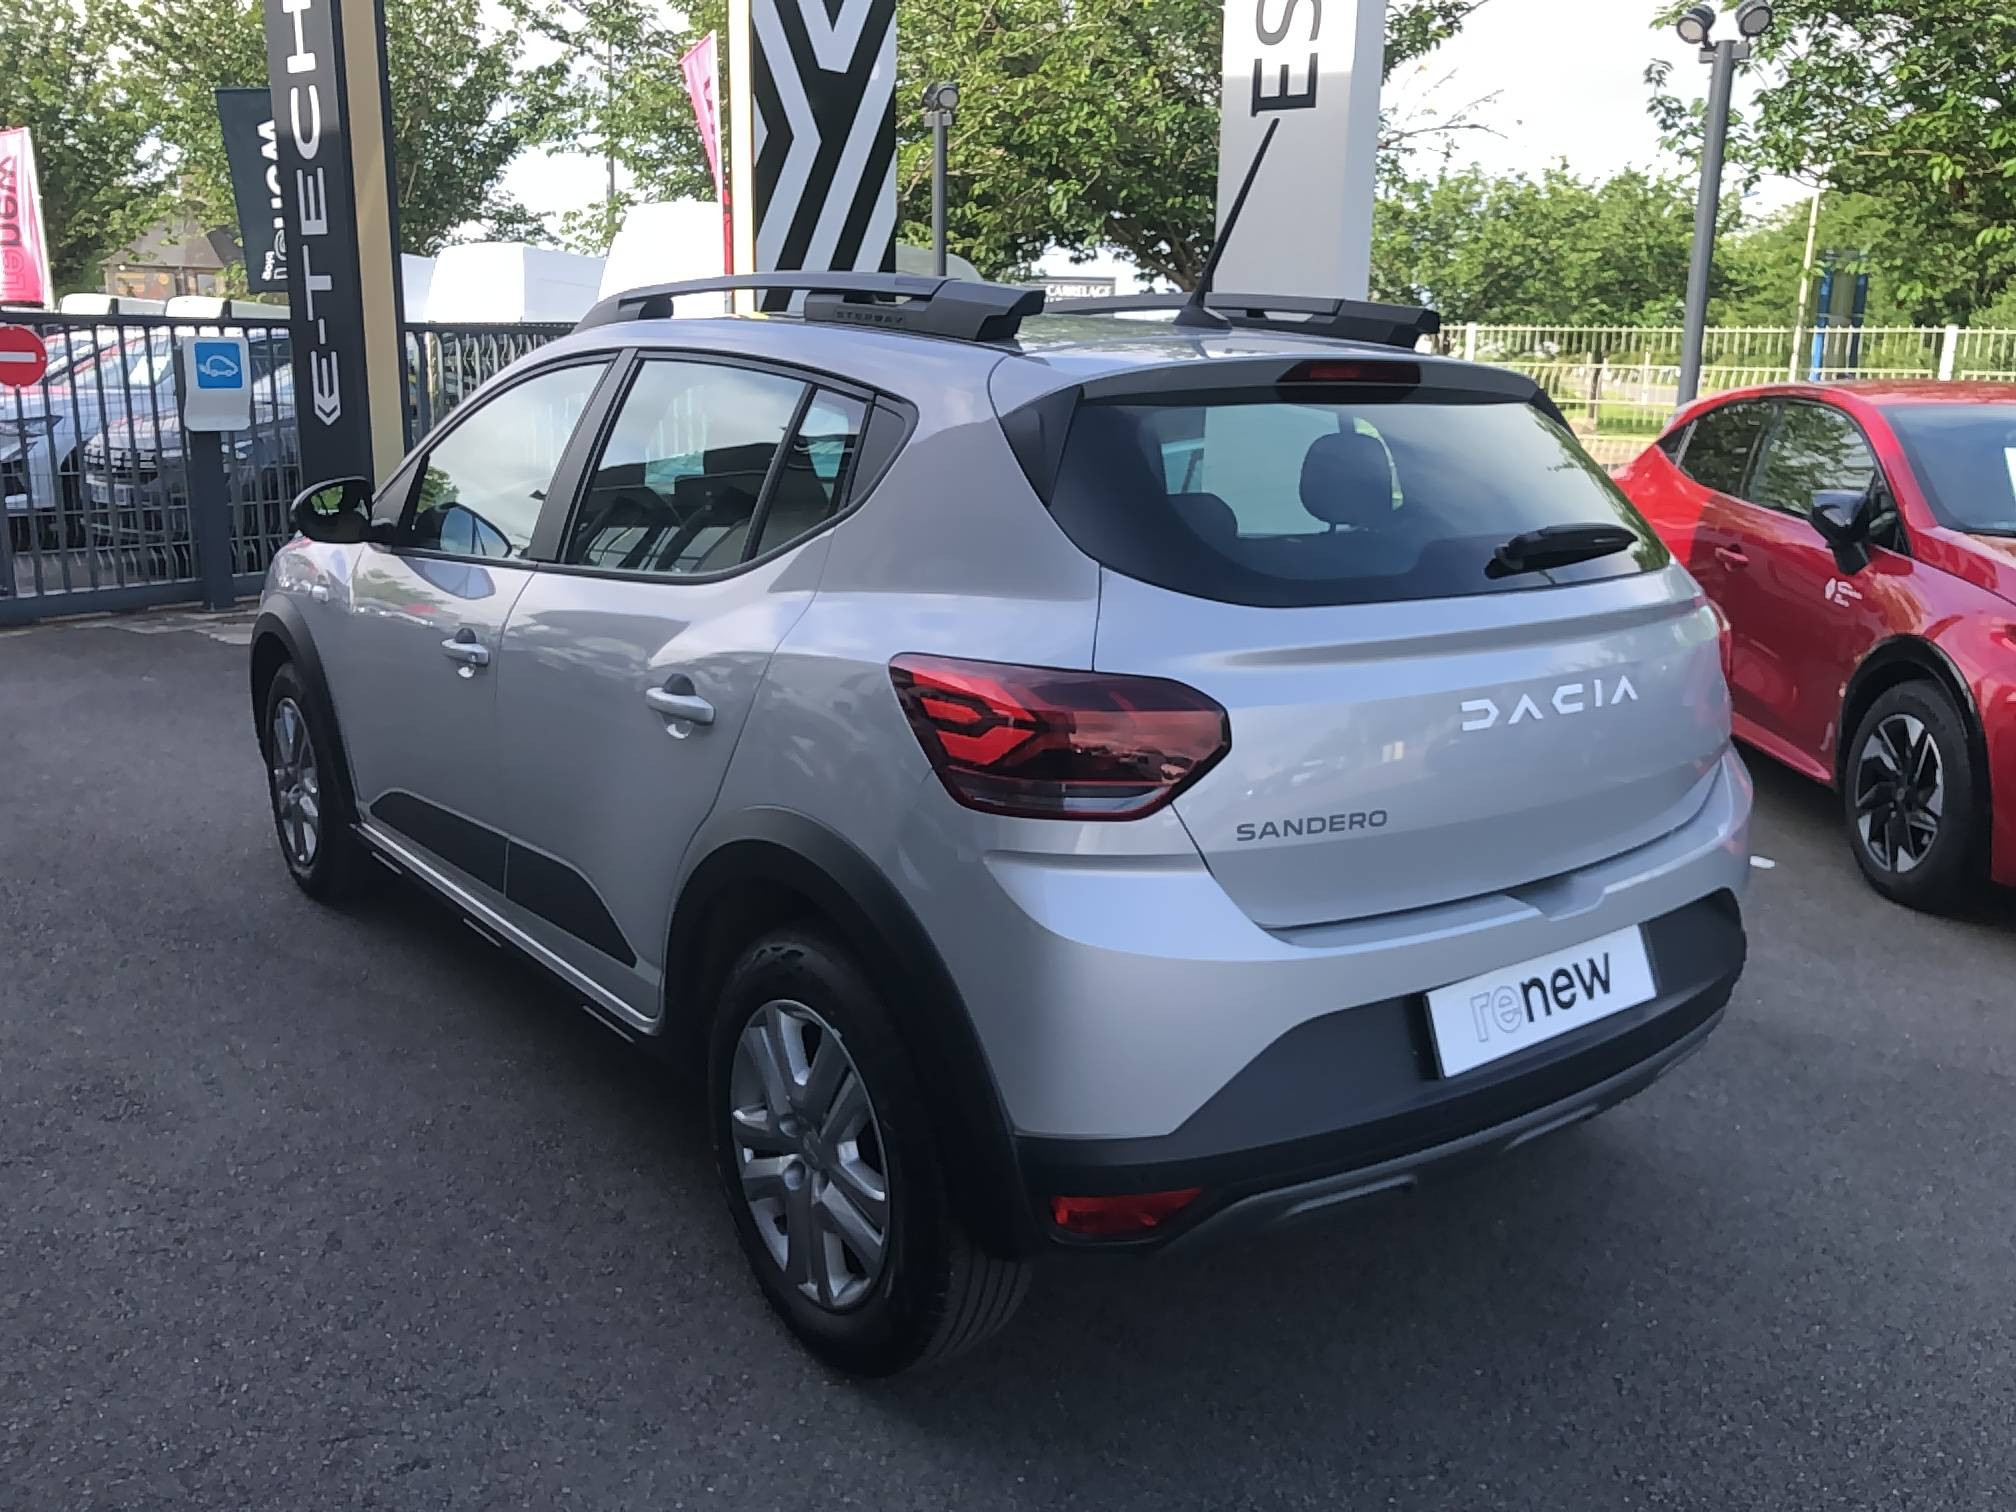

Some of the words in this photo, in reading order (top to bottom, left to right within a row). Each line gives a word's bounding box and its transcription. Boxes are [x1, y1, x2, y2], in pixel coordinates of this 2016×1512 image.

[282, 0, 342, 425] E-TECH
[1461, 675, 1639, 731] DACIA
[1236, 810, 1388, 842] SANDERO
[1469, 952, 1611, 1043] renew
